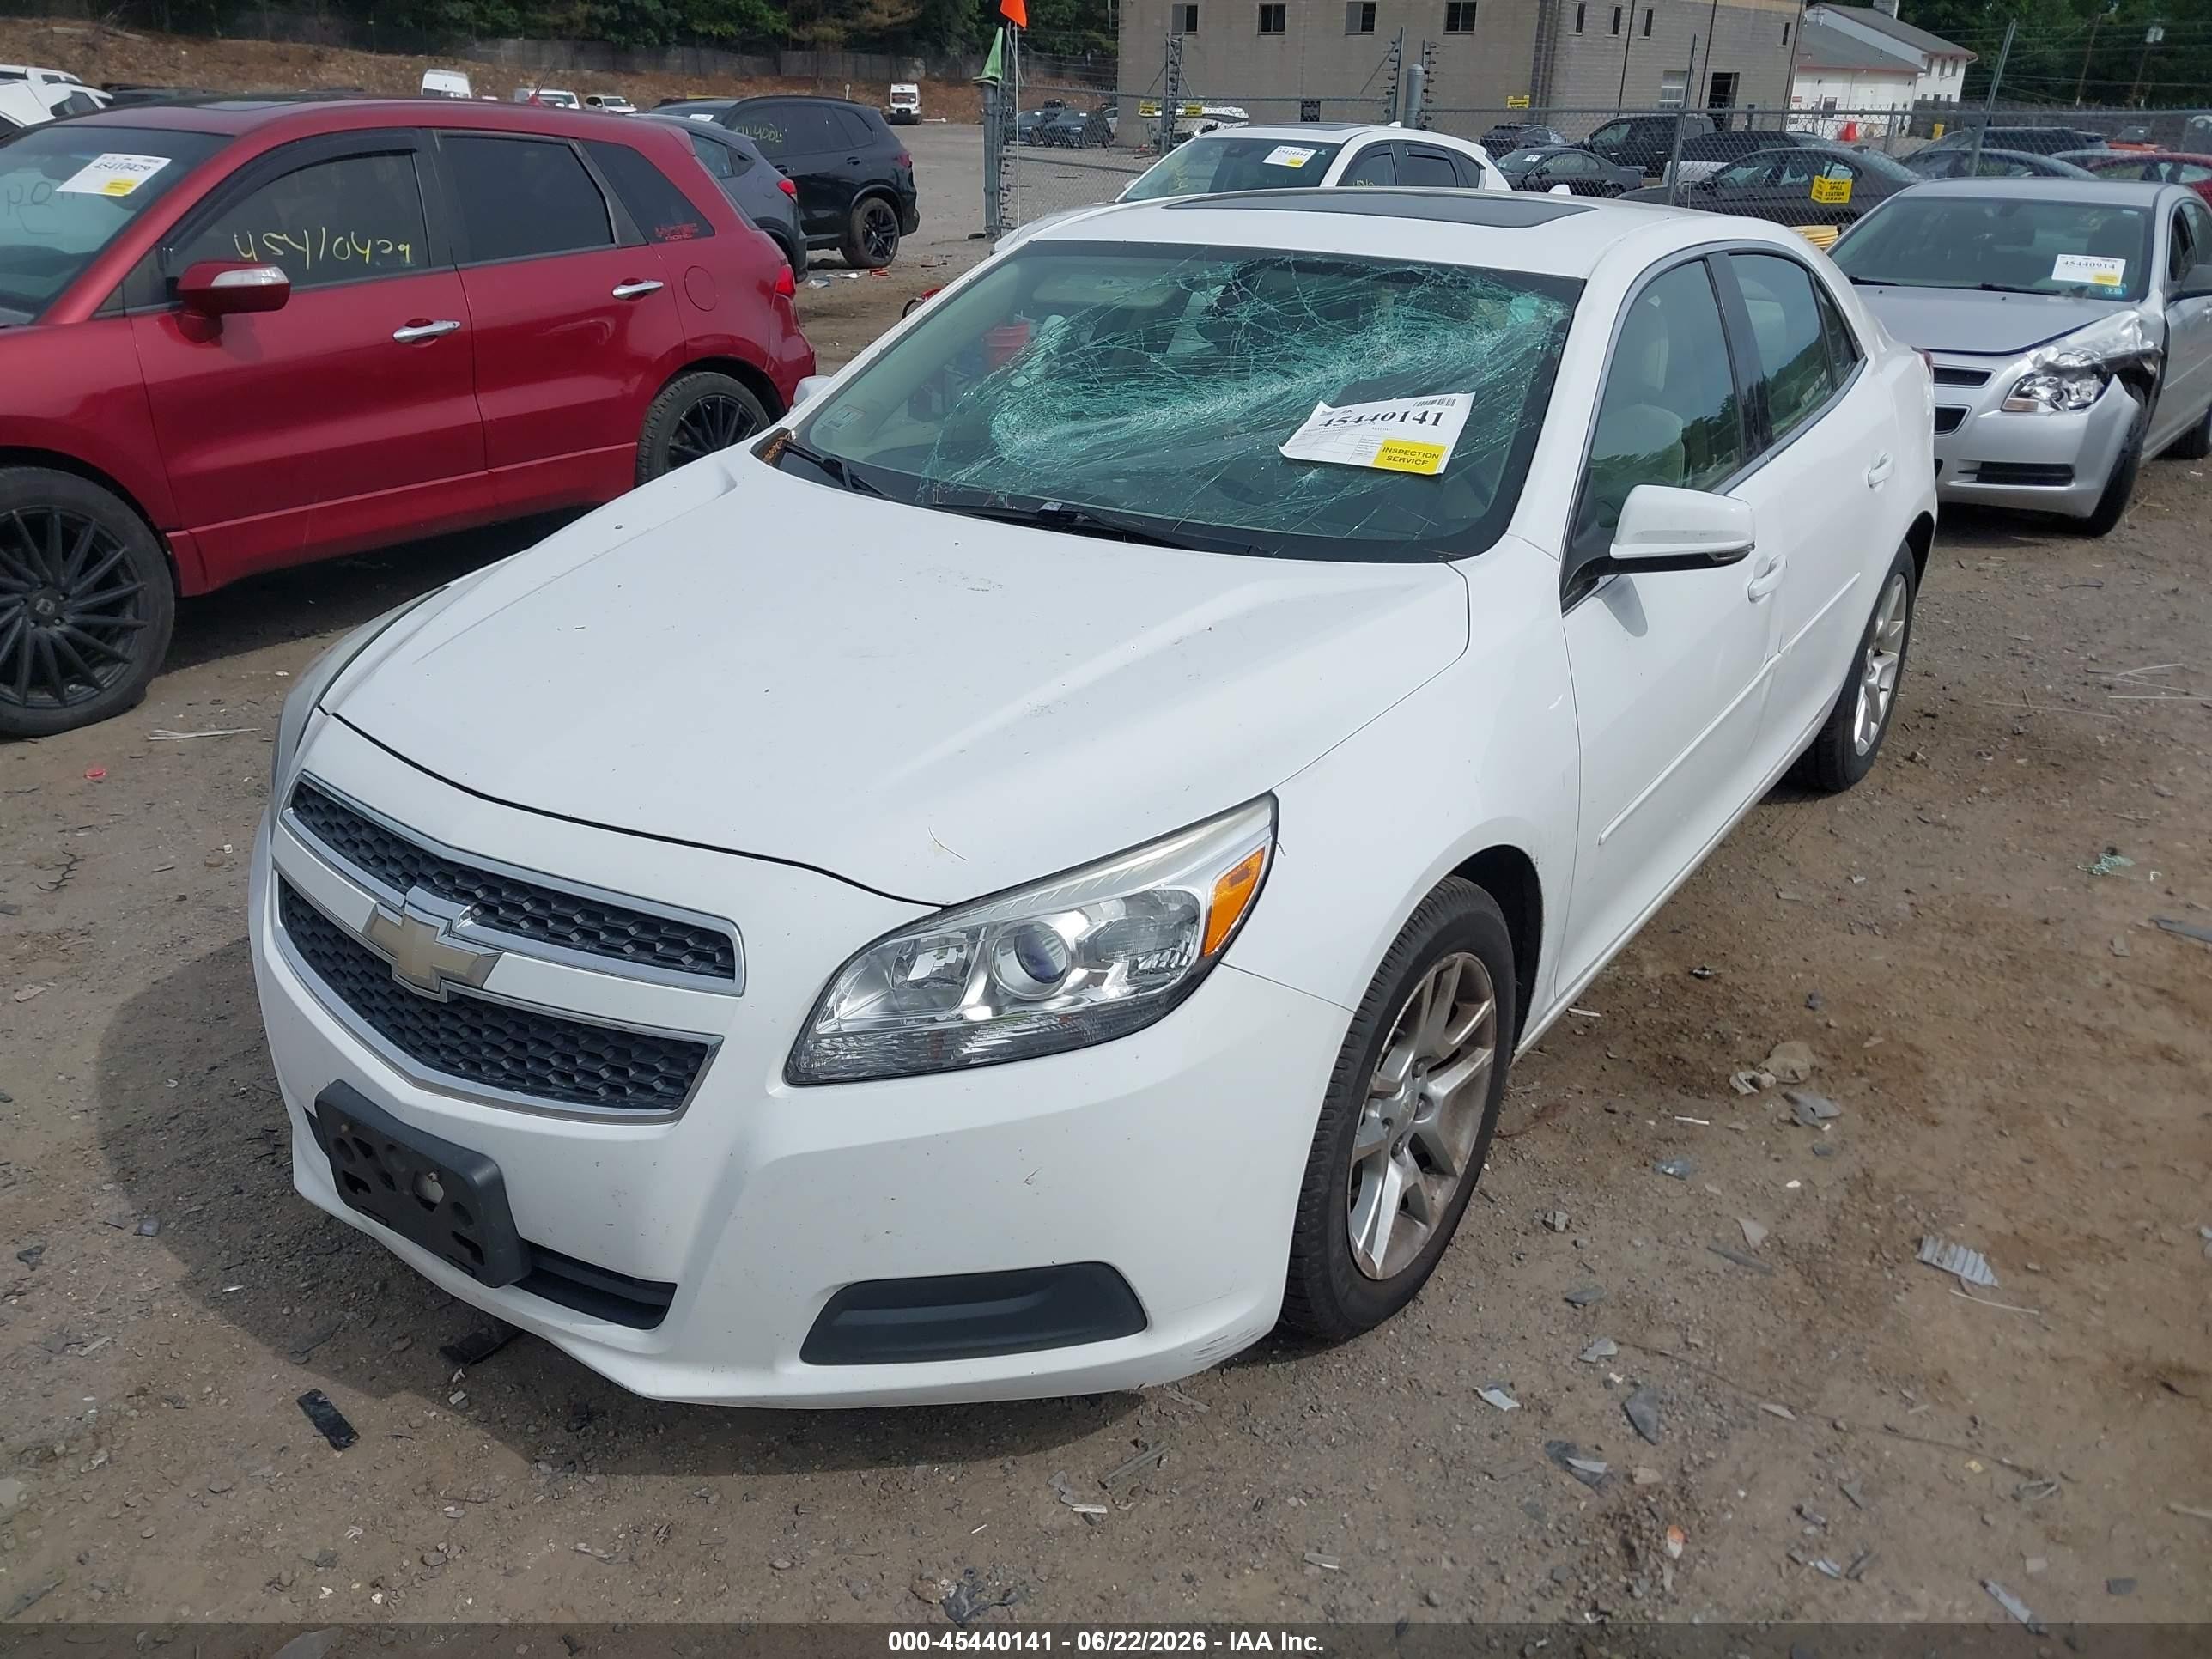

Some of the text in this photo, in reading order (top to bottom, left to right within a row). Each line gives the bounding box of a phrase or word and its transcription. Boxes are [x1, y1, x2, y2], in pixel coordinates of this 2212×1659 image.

[234, 227, 410, 270] 45410429
[2063, 260, 2116, 269] 45440914
[1319, 410, 1443, 428] 45440141
[1382, 447, 1439, 459] INSPECTION
[1386, 455, 1429, 466] SERVICE
